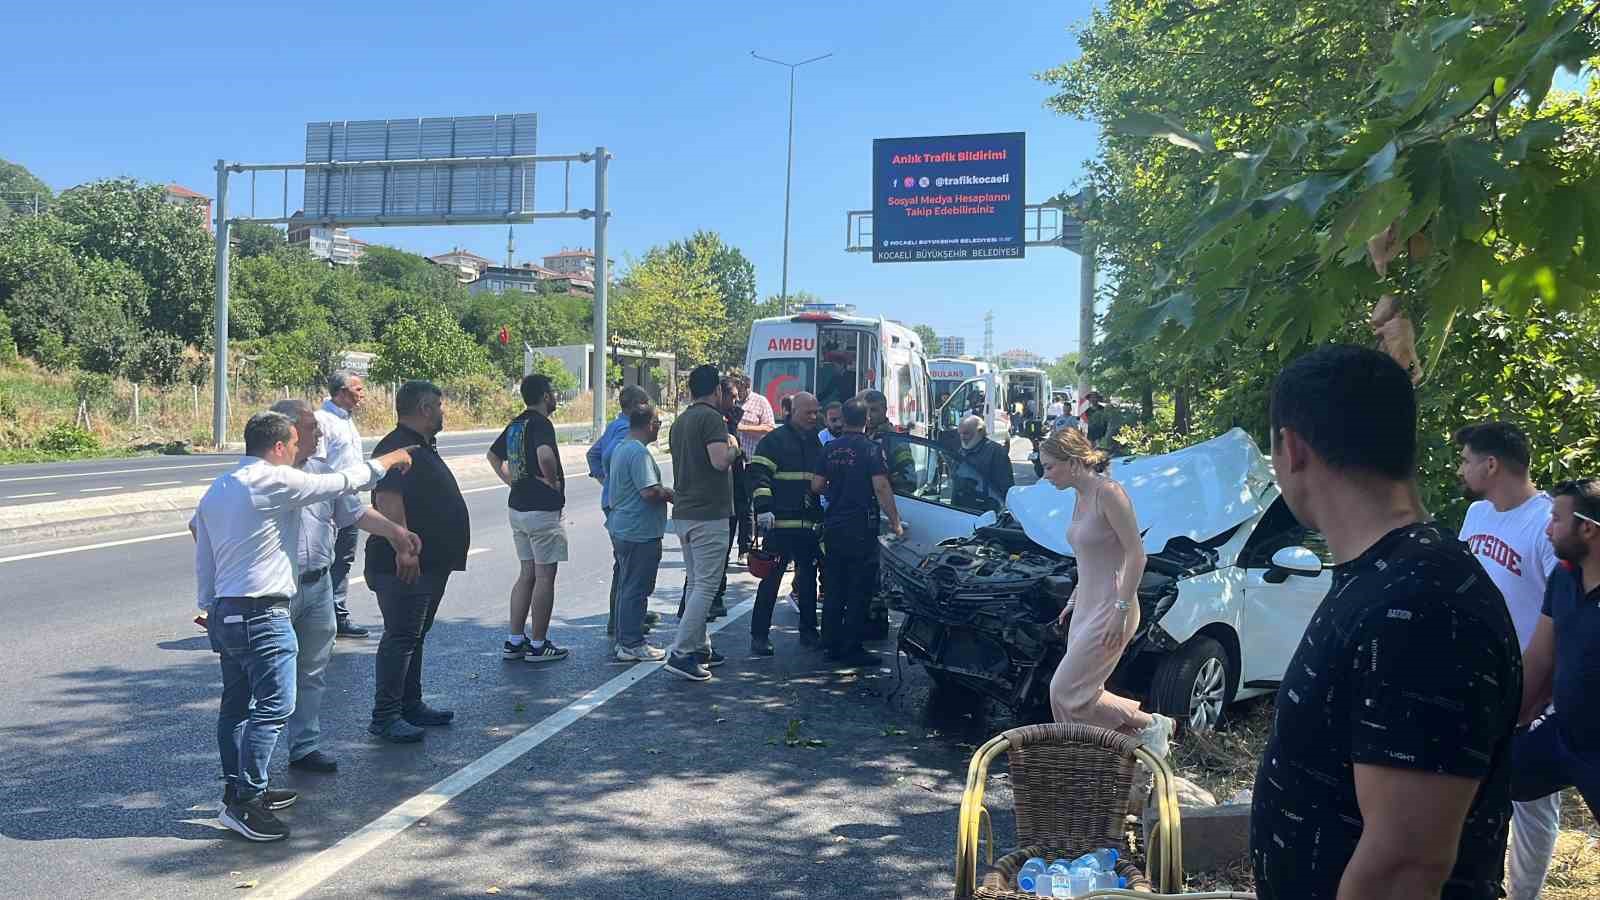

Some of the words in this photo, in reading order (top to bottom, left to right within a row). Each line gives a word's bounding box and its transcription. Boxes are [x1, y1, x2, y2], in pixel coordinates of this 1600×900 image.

[892, 154, 922, 165] Anlık
[923, 151, 957, 163] Trafik
[958, 149, 1007, 161] Bildirimi
[935, 173, 1010, 188] @trafikkocaeli
[888, 196, 919, 206] Sosyal
[920, 195, 953, 205] Medya
[905, 207, 933, 217] Takip
[934, 204, 995, 216] Edebilirsiniz
[768, 337, 815, 351] AMBU
